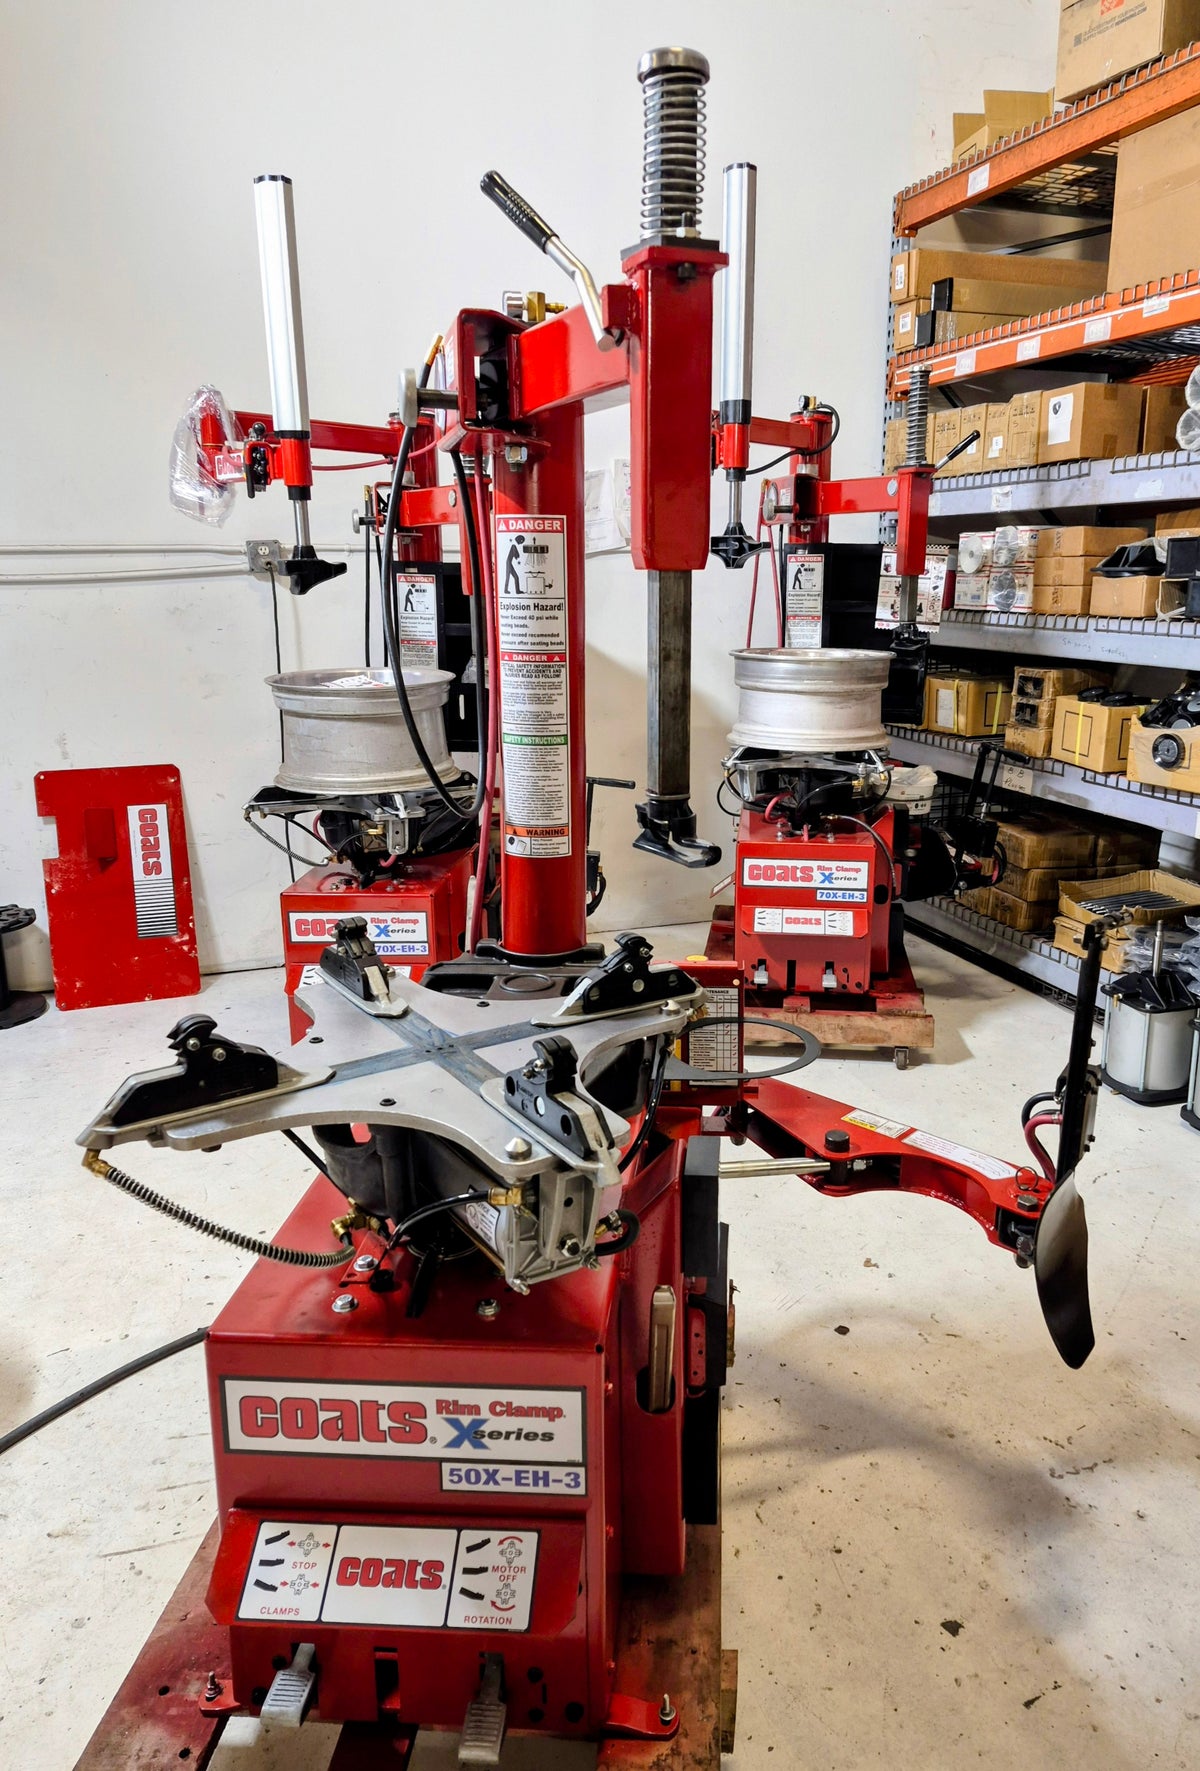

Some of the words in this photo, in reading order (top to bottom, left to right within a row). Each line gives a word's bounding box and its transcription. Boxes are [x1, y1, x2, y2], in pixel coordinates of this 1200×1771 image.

[508, 520, 562, 531] DANGER
[500, 602, 531, 612] Explosion
[533, 602, 564, 611] Hazard!
[522, 736, 565, 744] INSTRUCTIONS
[835, 865, 861, 874] Clamp
[819, 891, 865, 900] 70X-EH-3
[390, 917, 419, 926] Clamp
[377, 945, 427, 953] 70X-EH-3
[435, 1399, 482, 1417] Rim
[489, 1400, 565, 1422] Clamp
[448, 1467, 582, 1489] 50X-EH-3
[292, 1561, 317, 1570] STOP
[491, 1565, 527, 1575] MOTOR
[498, 1573, 517, 1583] OFF
[259, 1607, 300, 1616] CLAMPS
[464, 1615, 513, 1625] ROTATION
